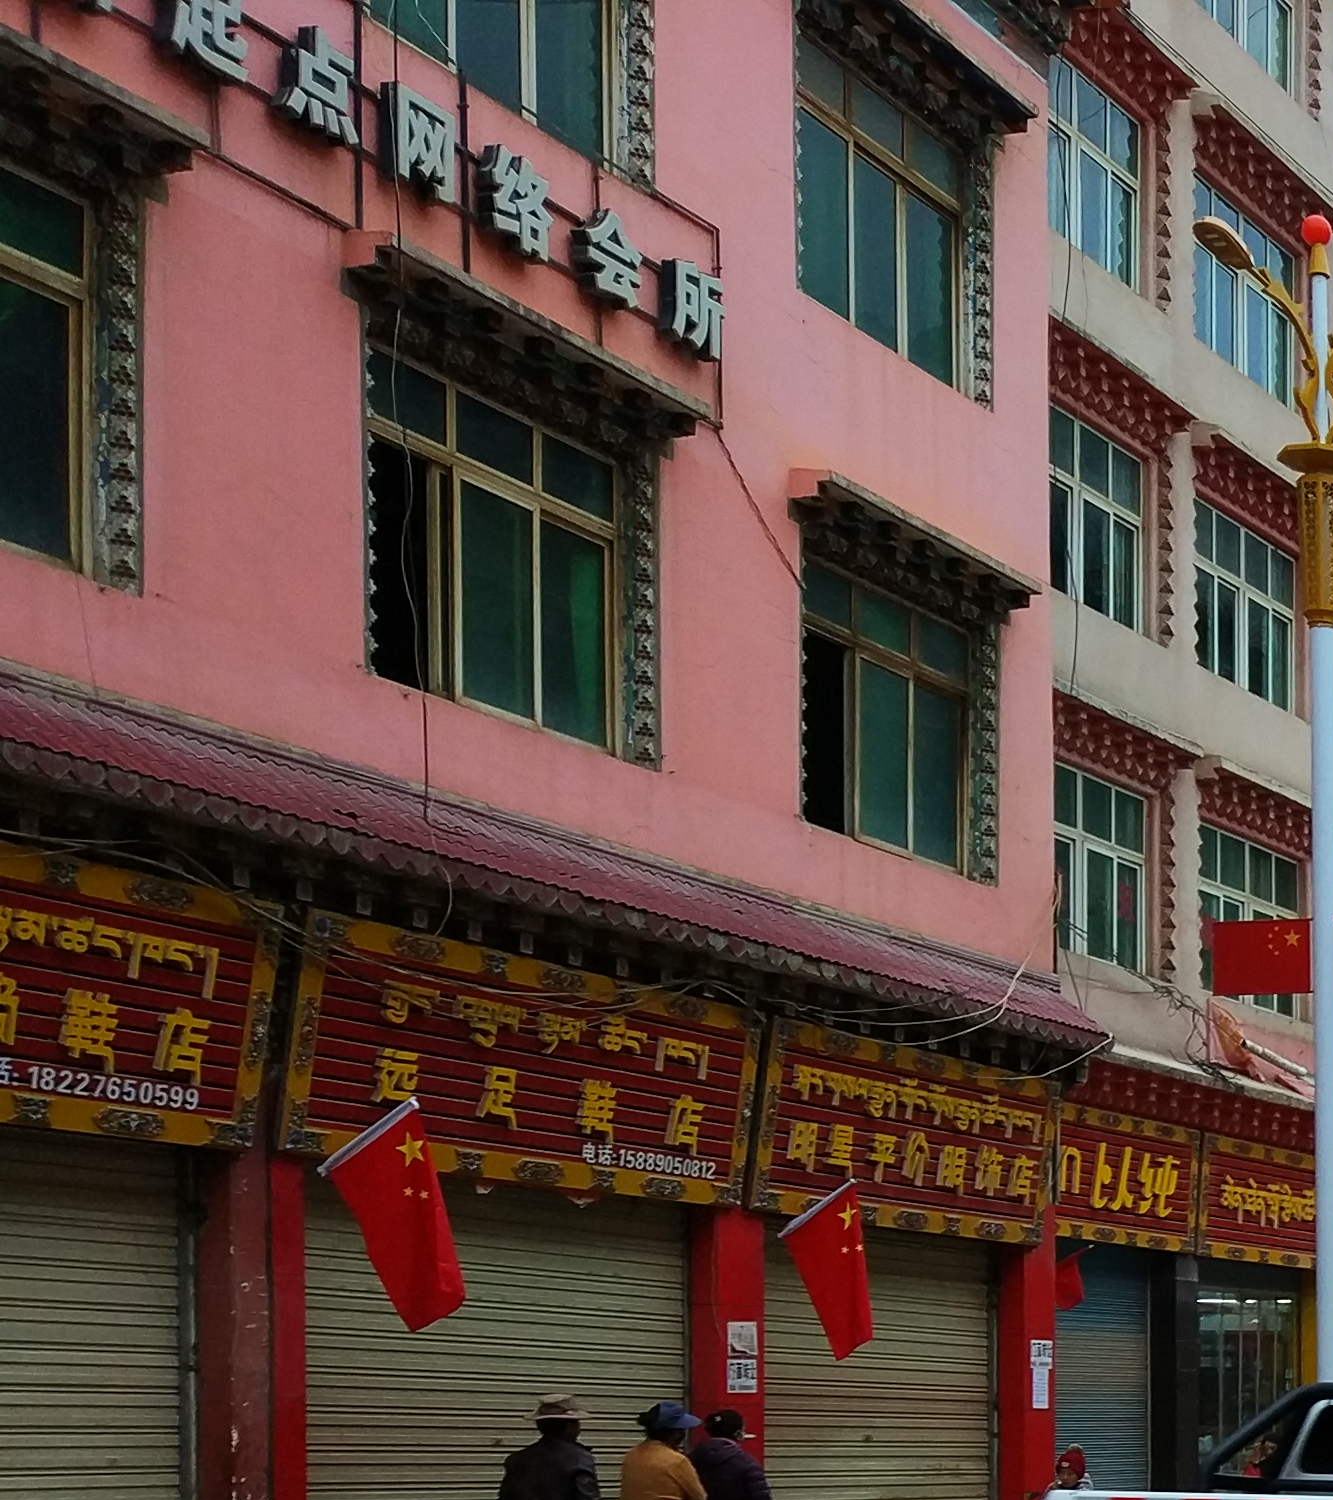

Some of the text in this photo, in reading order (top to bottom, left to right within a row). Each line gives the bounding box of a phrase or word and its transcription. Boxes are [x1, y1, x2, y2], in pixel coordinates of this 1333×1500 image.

[62, 0, 726, 362] 起点网络会所
[27, 1065, 200, 1111] 18227650599
[370, 1047, 706, 1156] 远足鞋店
[786, 1121, 1036, 1206] 明星平价服饰店
